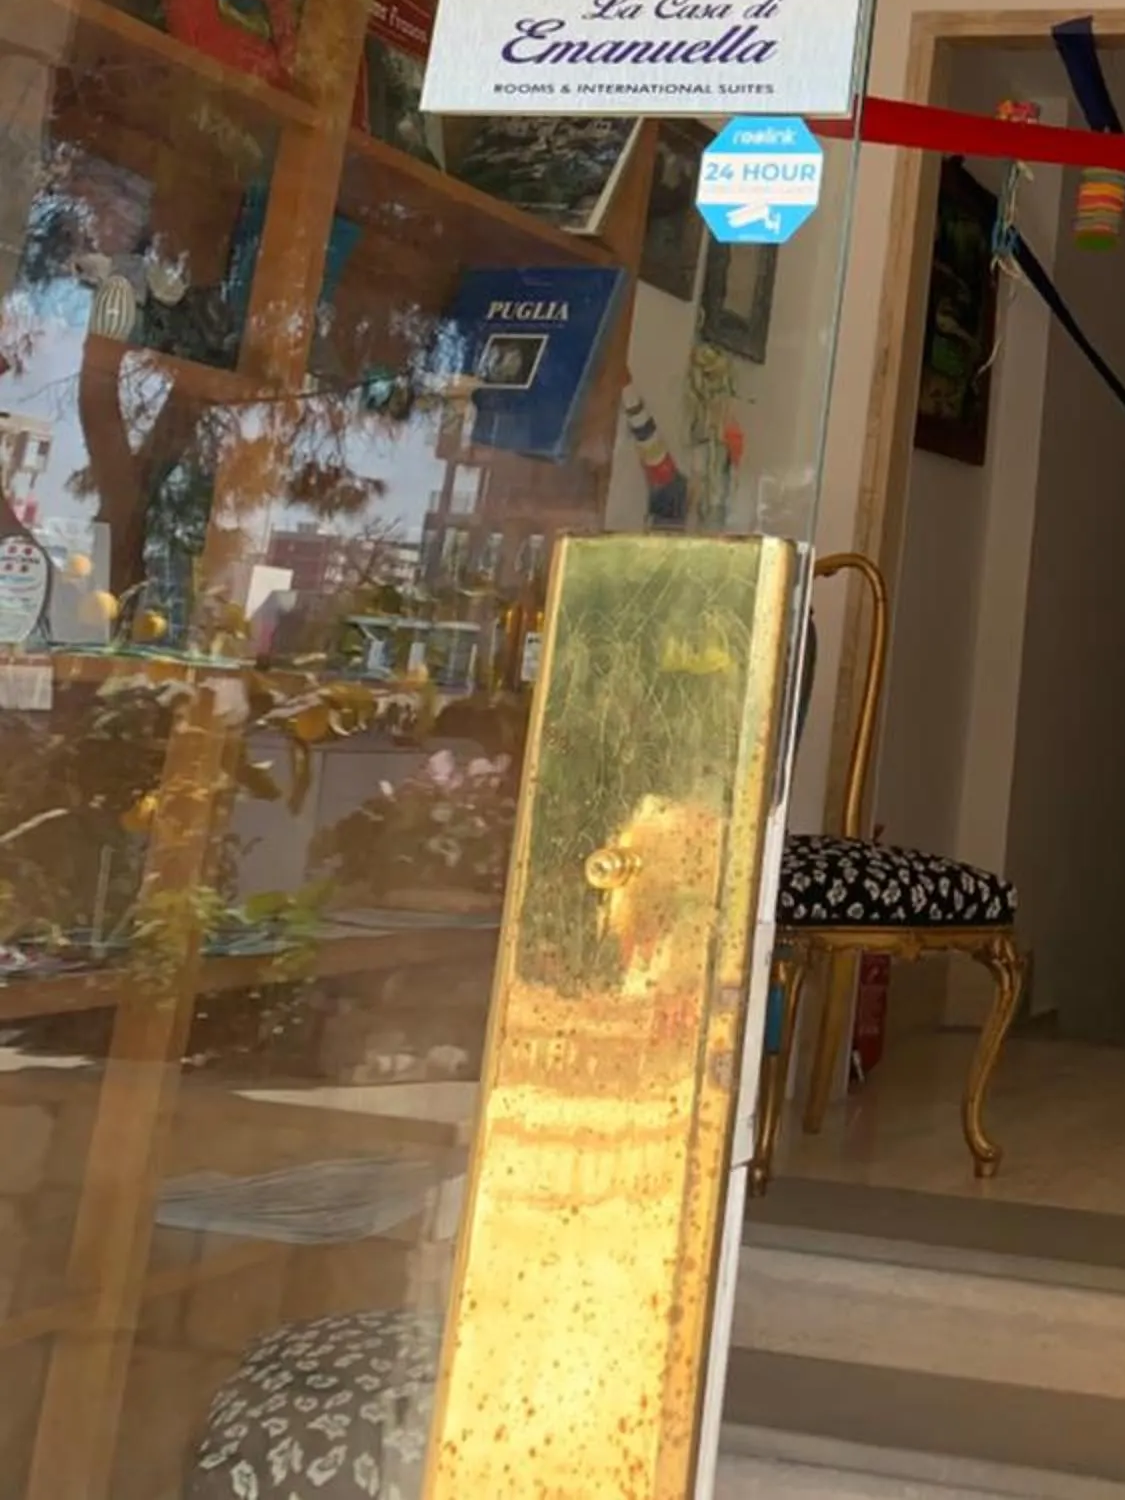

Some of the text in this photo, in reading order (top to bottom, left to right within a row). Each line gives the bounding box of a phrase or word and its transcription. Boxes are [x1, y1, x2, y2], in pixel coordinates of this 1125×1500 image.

[500, 17, 779, 64] Emanuella
[493, 82, 774, 95] ROOMS & INTERNATIONAL SUITES
[703, 161, 817, 182] 24 HOUR
[486, 301, 569, 321] PUGLIA
